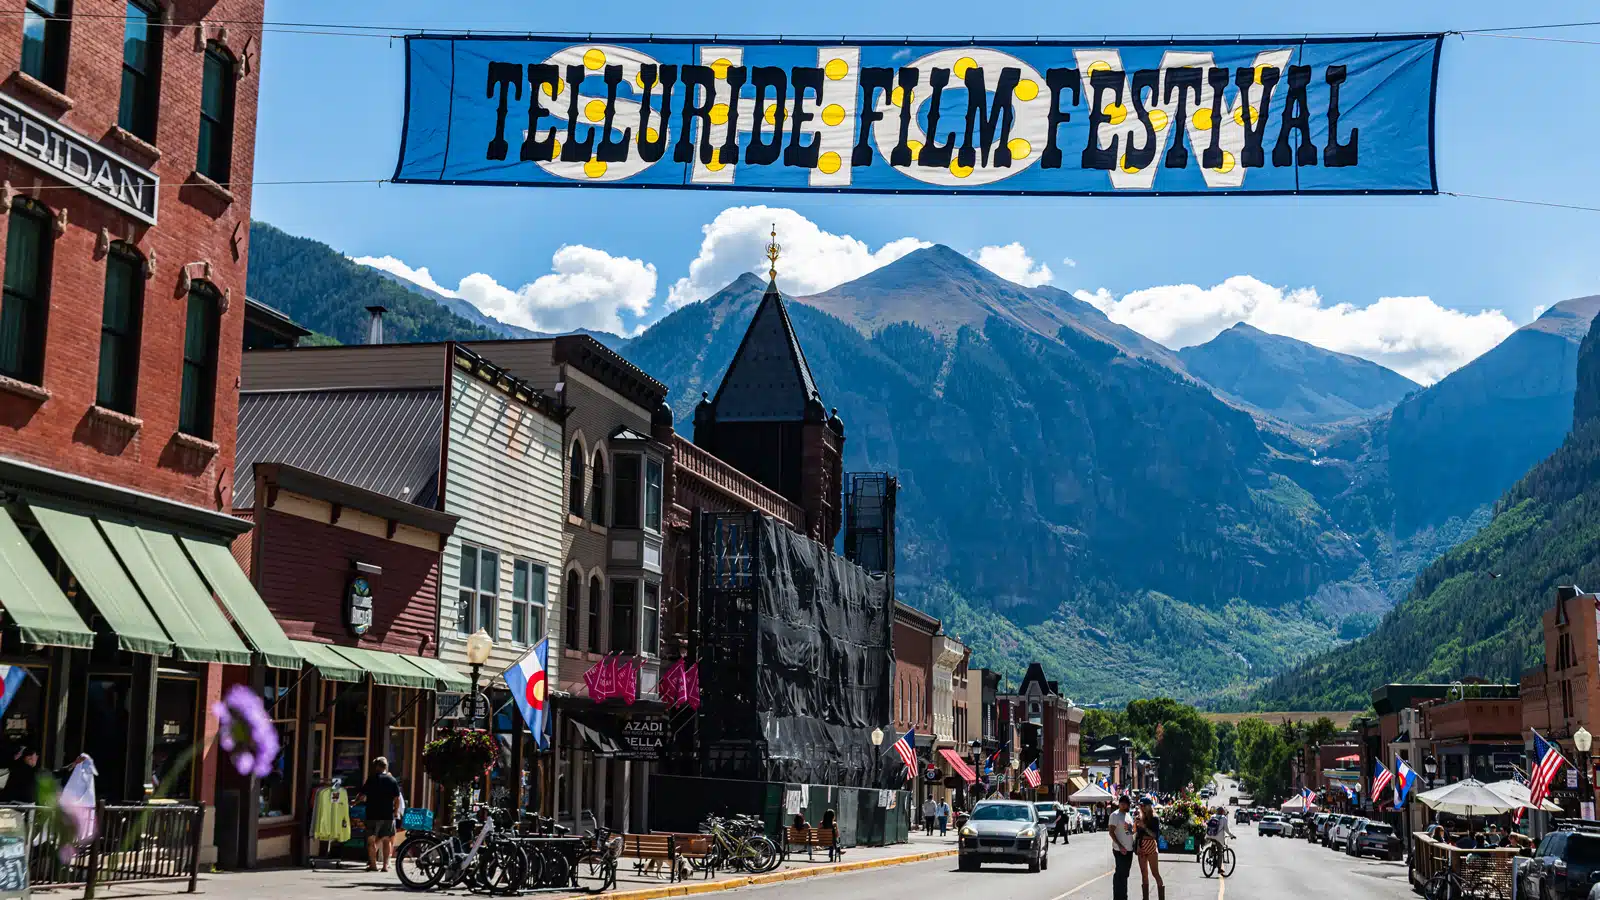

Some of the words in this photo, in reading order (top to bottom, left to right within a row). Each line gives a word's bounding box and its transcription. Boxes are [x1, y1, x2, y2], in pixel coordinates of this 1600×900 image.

[486, 61, 824, 166] TELLURIDE
[852, 66, 1021, 168] FILM
[1040, 64, 1359, 168] FESTIVAL
[624, 721, 663, 731] AZADI
